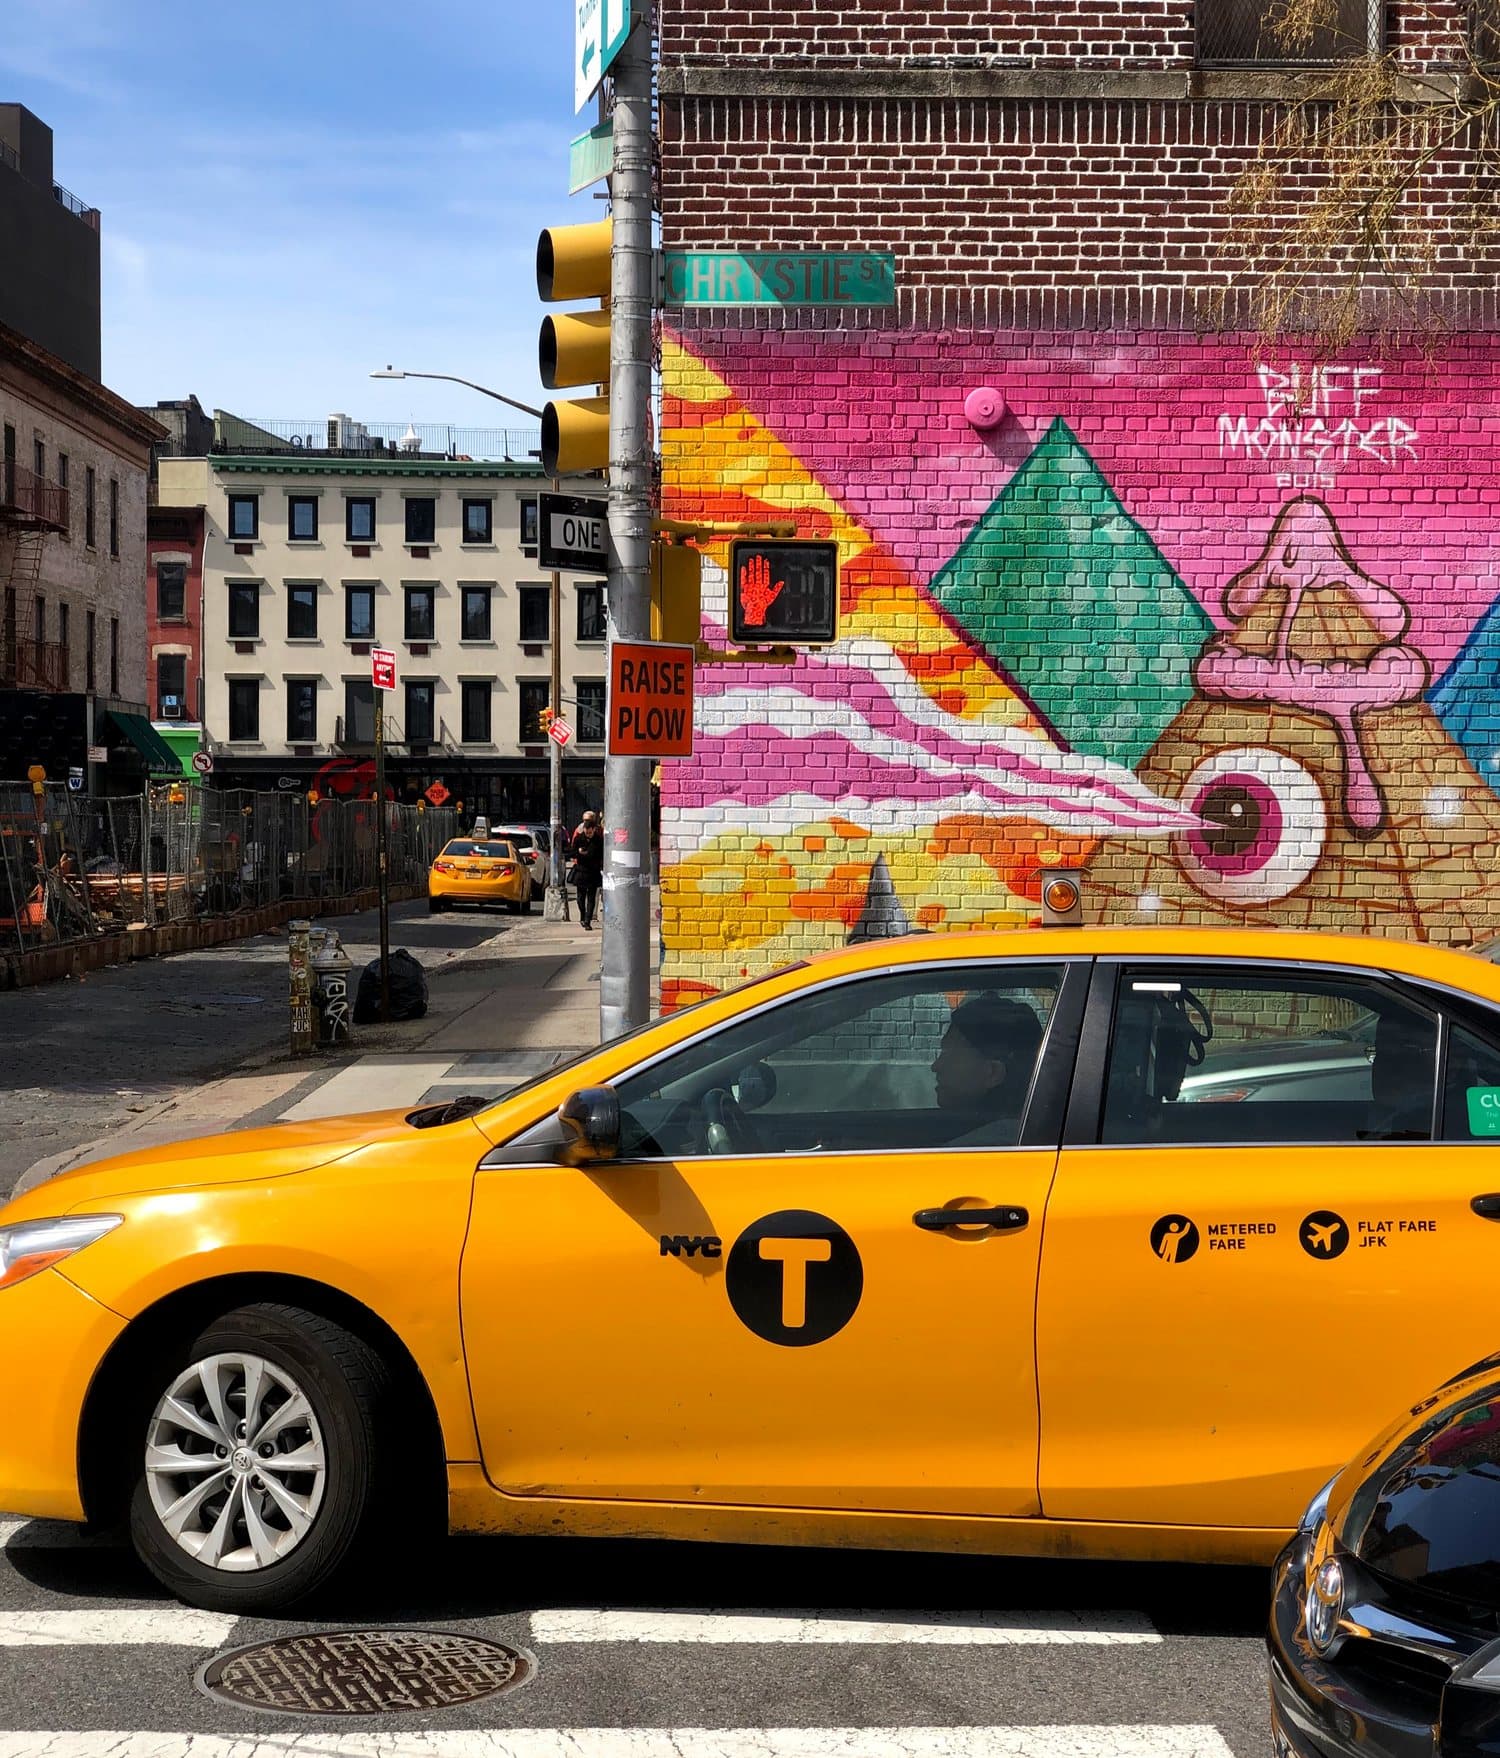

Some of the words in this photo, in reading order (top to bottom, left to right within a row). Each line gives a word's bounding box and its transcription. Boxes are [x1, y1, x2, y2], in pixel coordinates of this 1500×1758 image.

[666, 258, 854, 300] CHRYSTIE
[860, 259, 887, 280] ST
[1256, 363, 1383, 417] BUFF
[1218, 413, 1420, 470] MONSTER
[1277, 473, 1335, 489] 2015
[563, 518, 601, 549] ONE
[620, 659, 685, 695] RAISE
[618, 706, 686, 741] PLOW
[1208, 1223, 1276, 1236] METERED
[1358, 1221, 1394, 1233] FLAT
[1399, 1220, 1437, 1232] FARE
[1359, 1236, 1387, 1248] JFK
[660, 1235, 722, 1258] NYC
[1209, 1239, 1246, 1250] FARE
[758, 1237, 832, 1328] T
